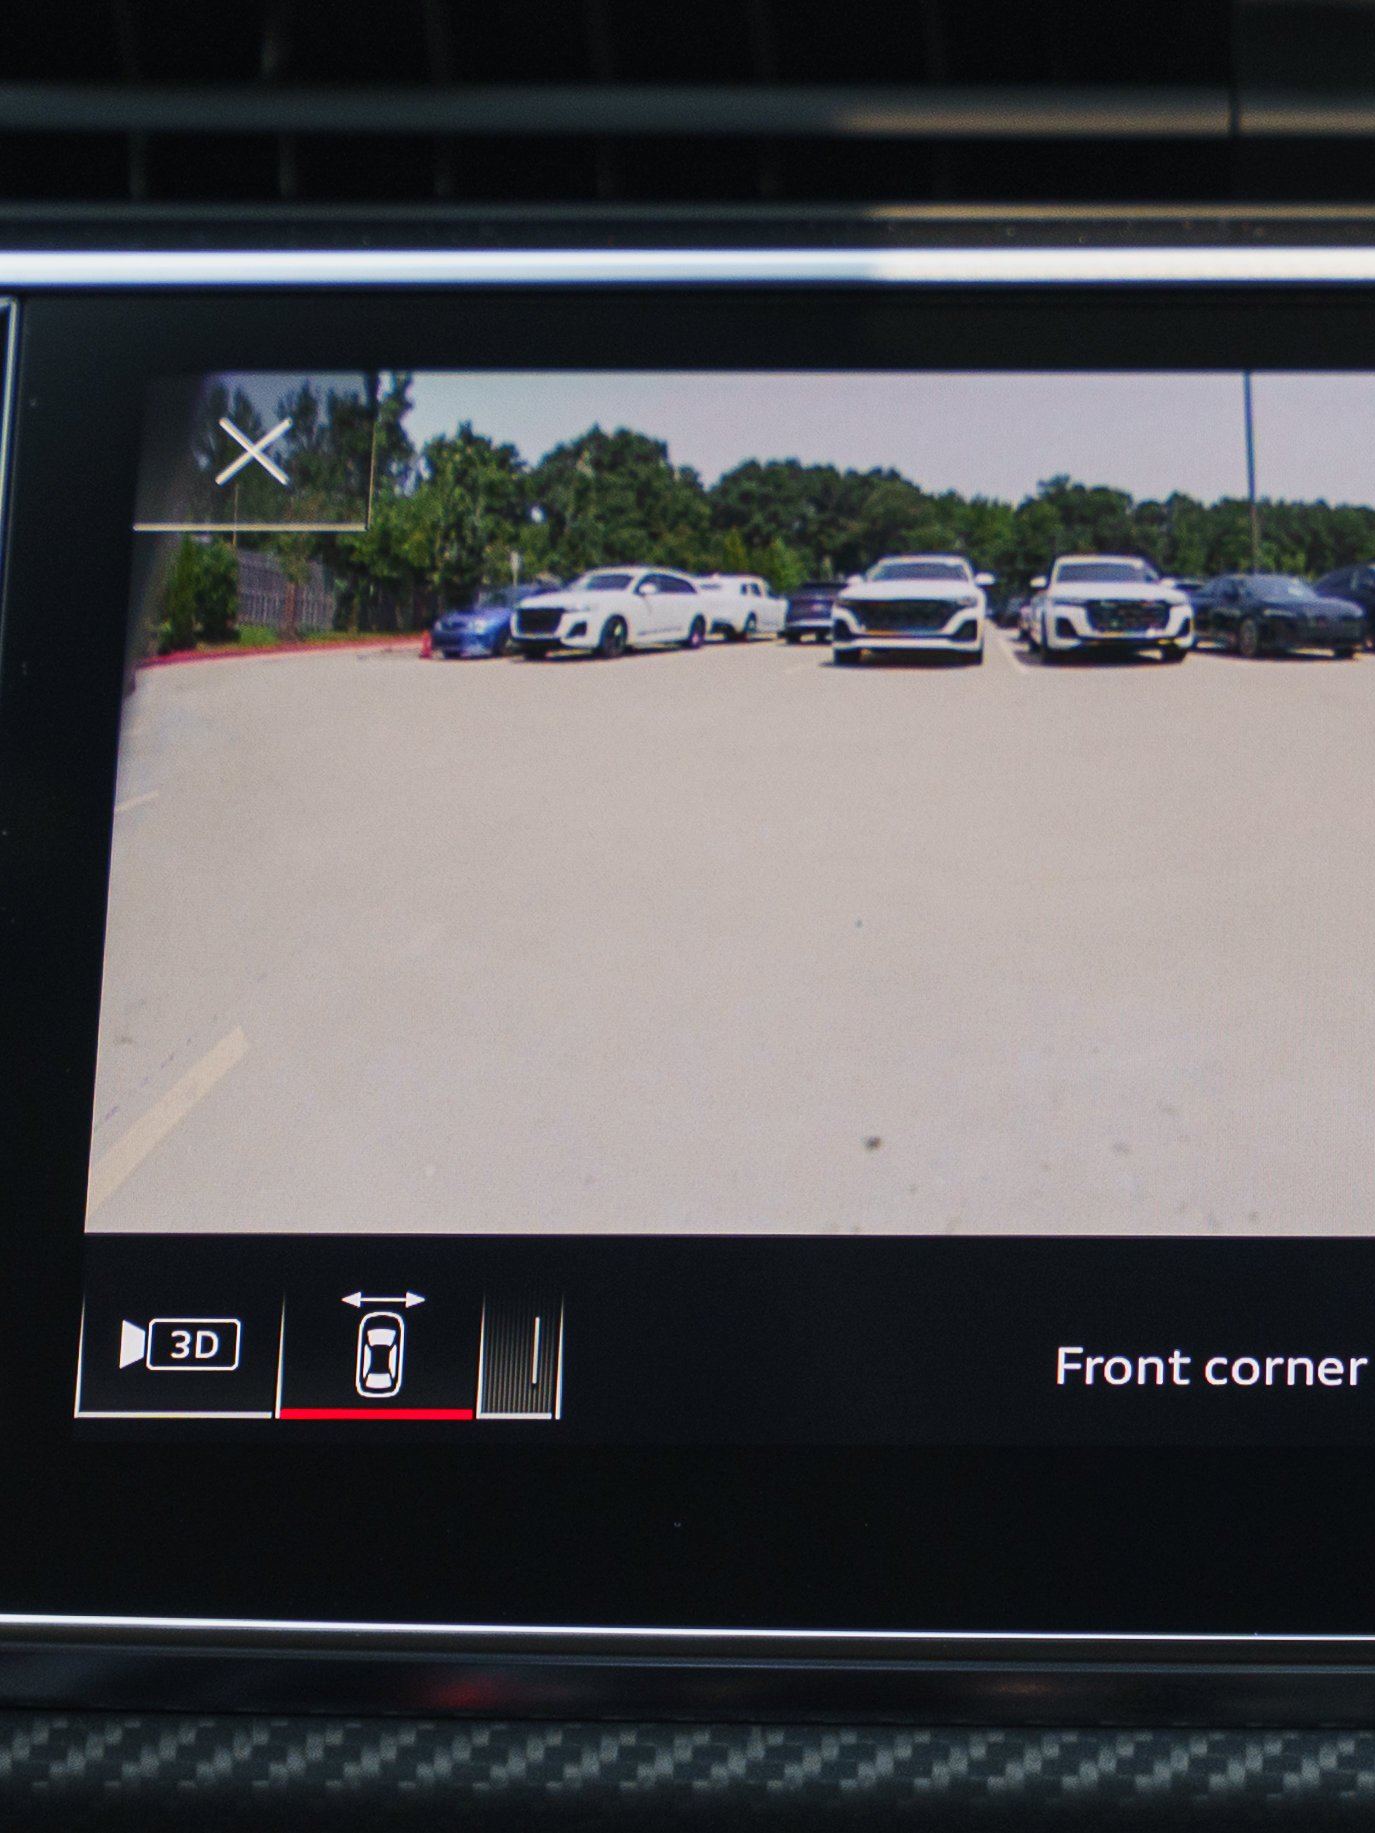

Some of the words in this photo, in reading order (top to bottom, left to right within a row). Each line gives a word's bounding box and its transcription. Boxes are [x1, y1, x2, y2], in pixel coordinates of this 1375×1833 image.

[169, 1329, 220, 1360] 3D
[1055, 1346, 1191, 1386] Front
[1204, 1355, 1369, 1387] corner
